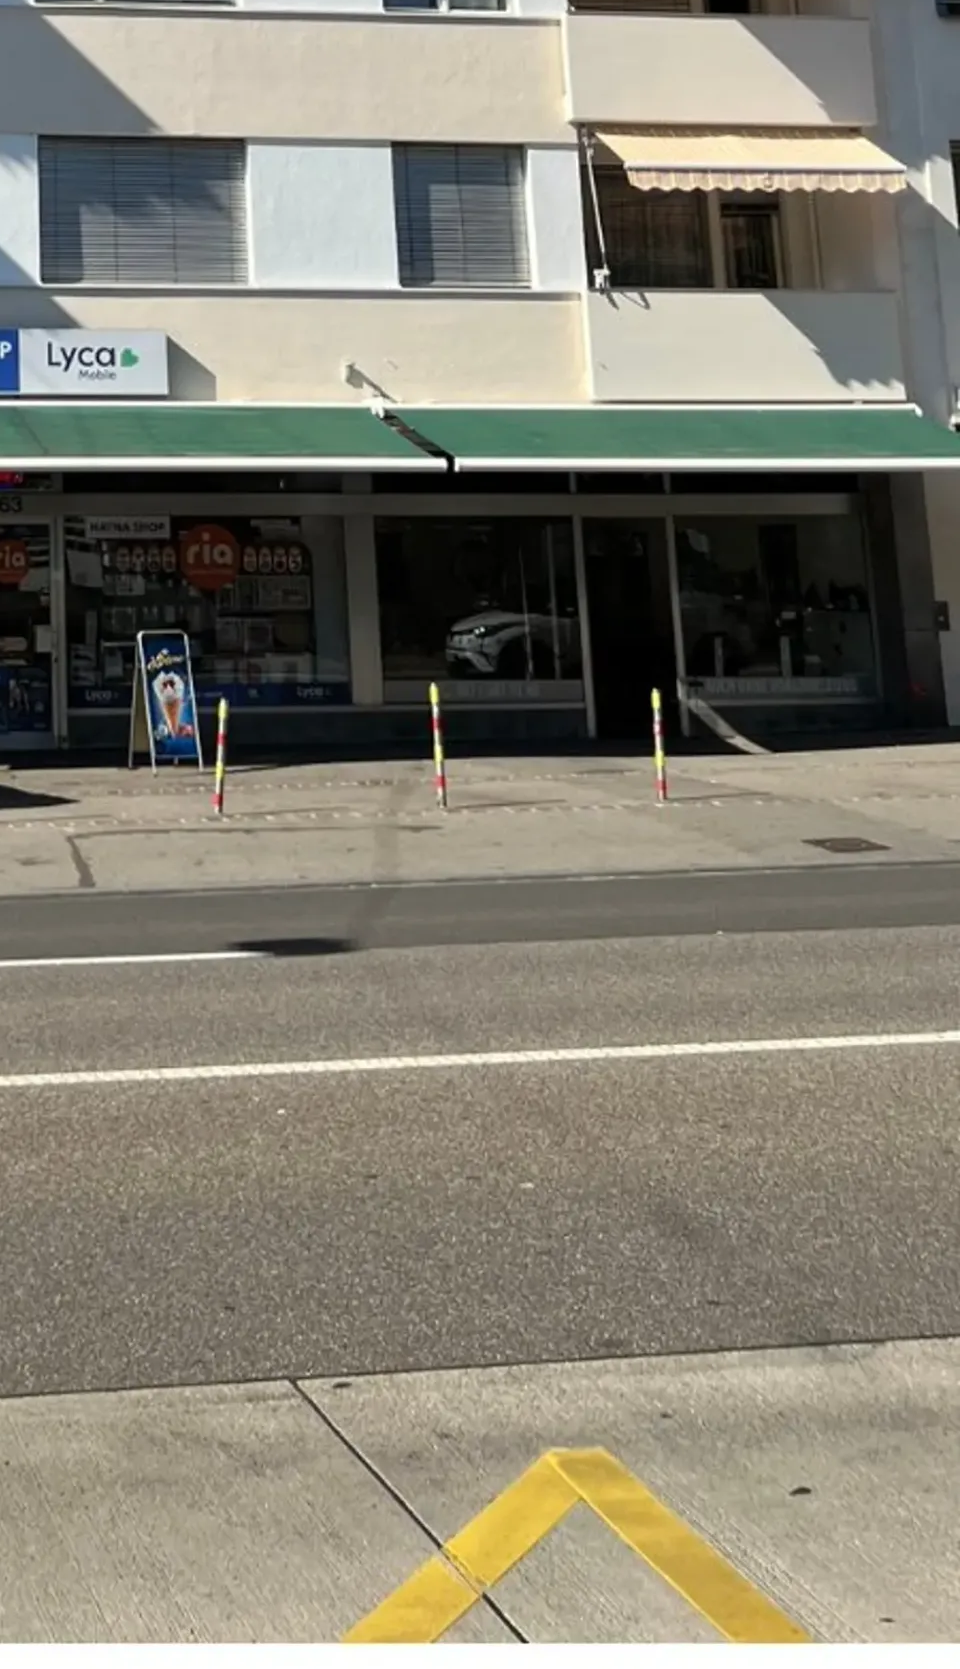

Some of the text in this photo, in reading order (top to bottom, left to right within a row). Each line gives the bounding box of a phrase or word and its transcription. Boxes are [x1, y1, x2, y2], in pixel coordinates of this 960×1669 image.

[47, 341, 116, 372] Lyca
[78, 370, 116, 381] Mobile
[186, 532, 233, 565] ria
